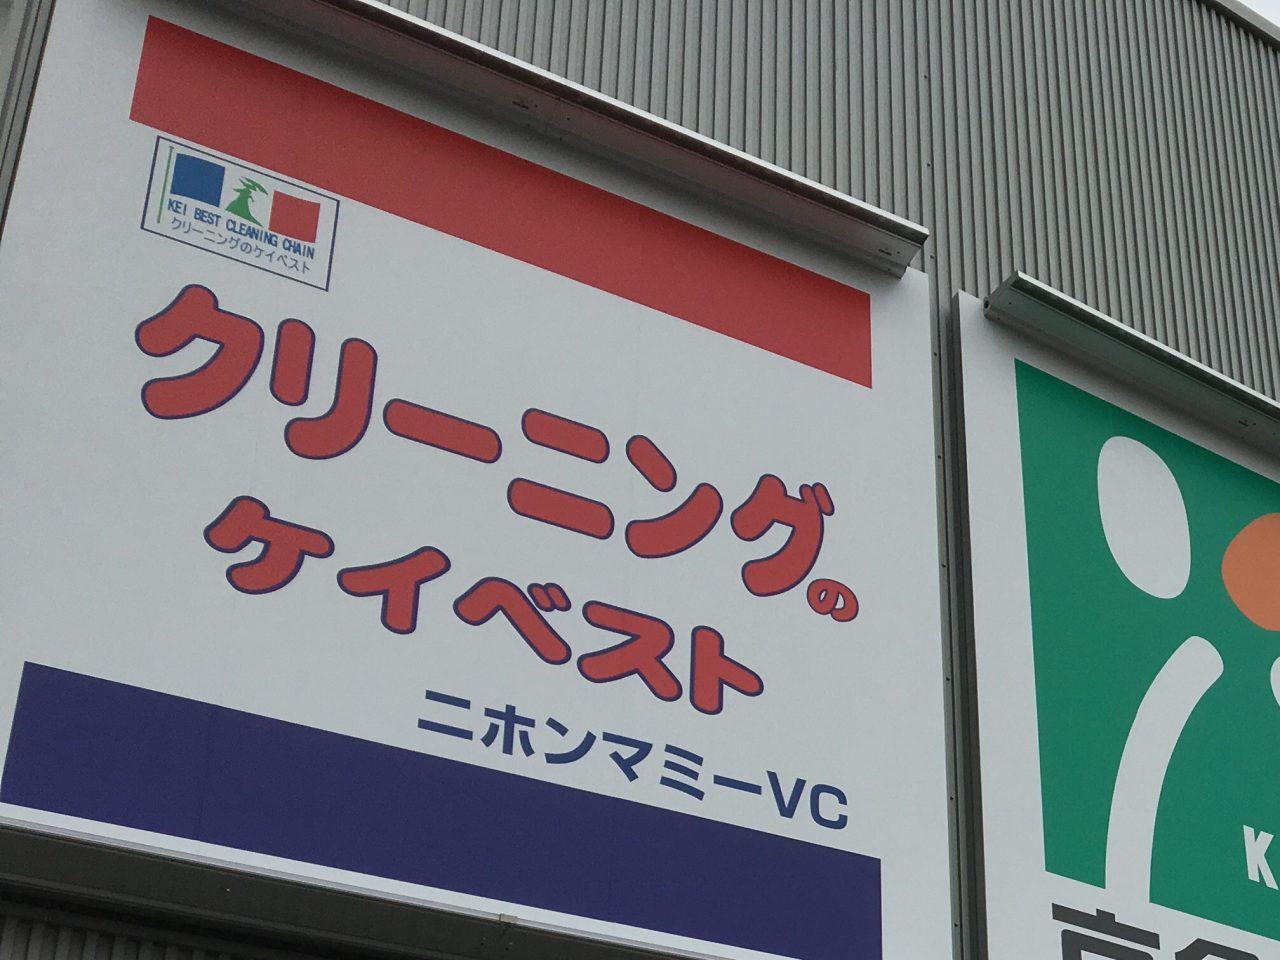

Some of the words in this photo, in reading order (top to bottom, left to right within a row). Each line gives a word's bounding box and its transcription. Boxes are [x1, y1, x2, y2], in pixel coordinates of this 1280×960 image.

[167, 198, 187, 217] KEI
[194, 207, 222, 227] BEST
[226, 219, 278, 247] CLEANING
[282, 238, 315, 259] CHAIN
[171, 217, 311, 274] クリーニングのケイベスト
[135, 284, 859, 623] クリーニングの
[203, 495, 764, 714] ケイベスト
[417, 689, 849, 831] ニホンマミーVC
